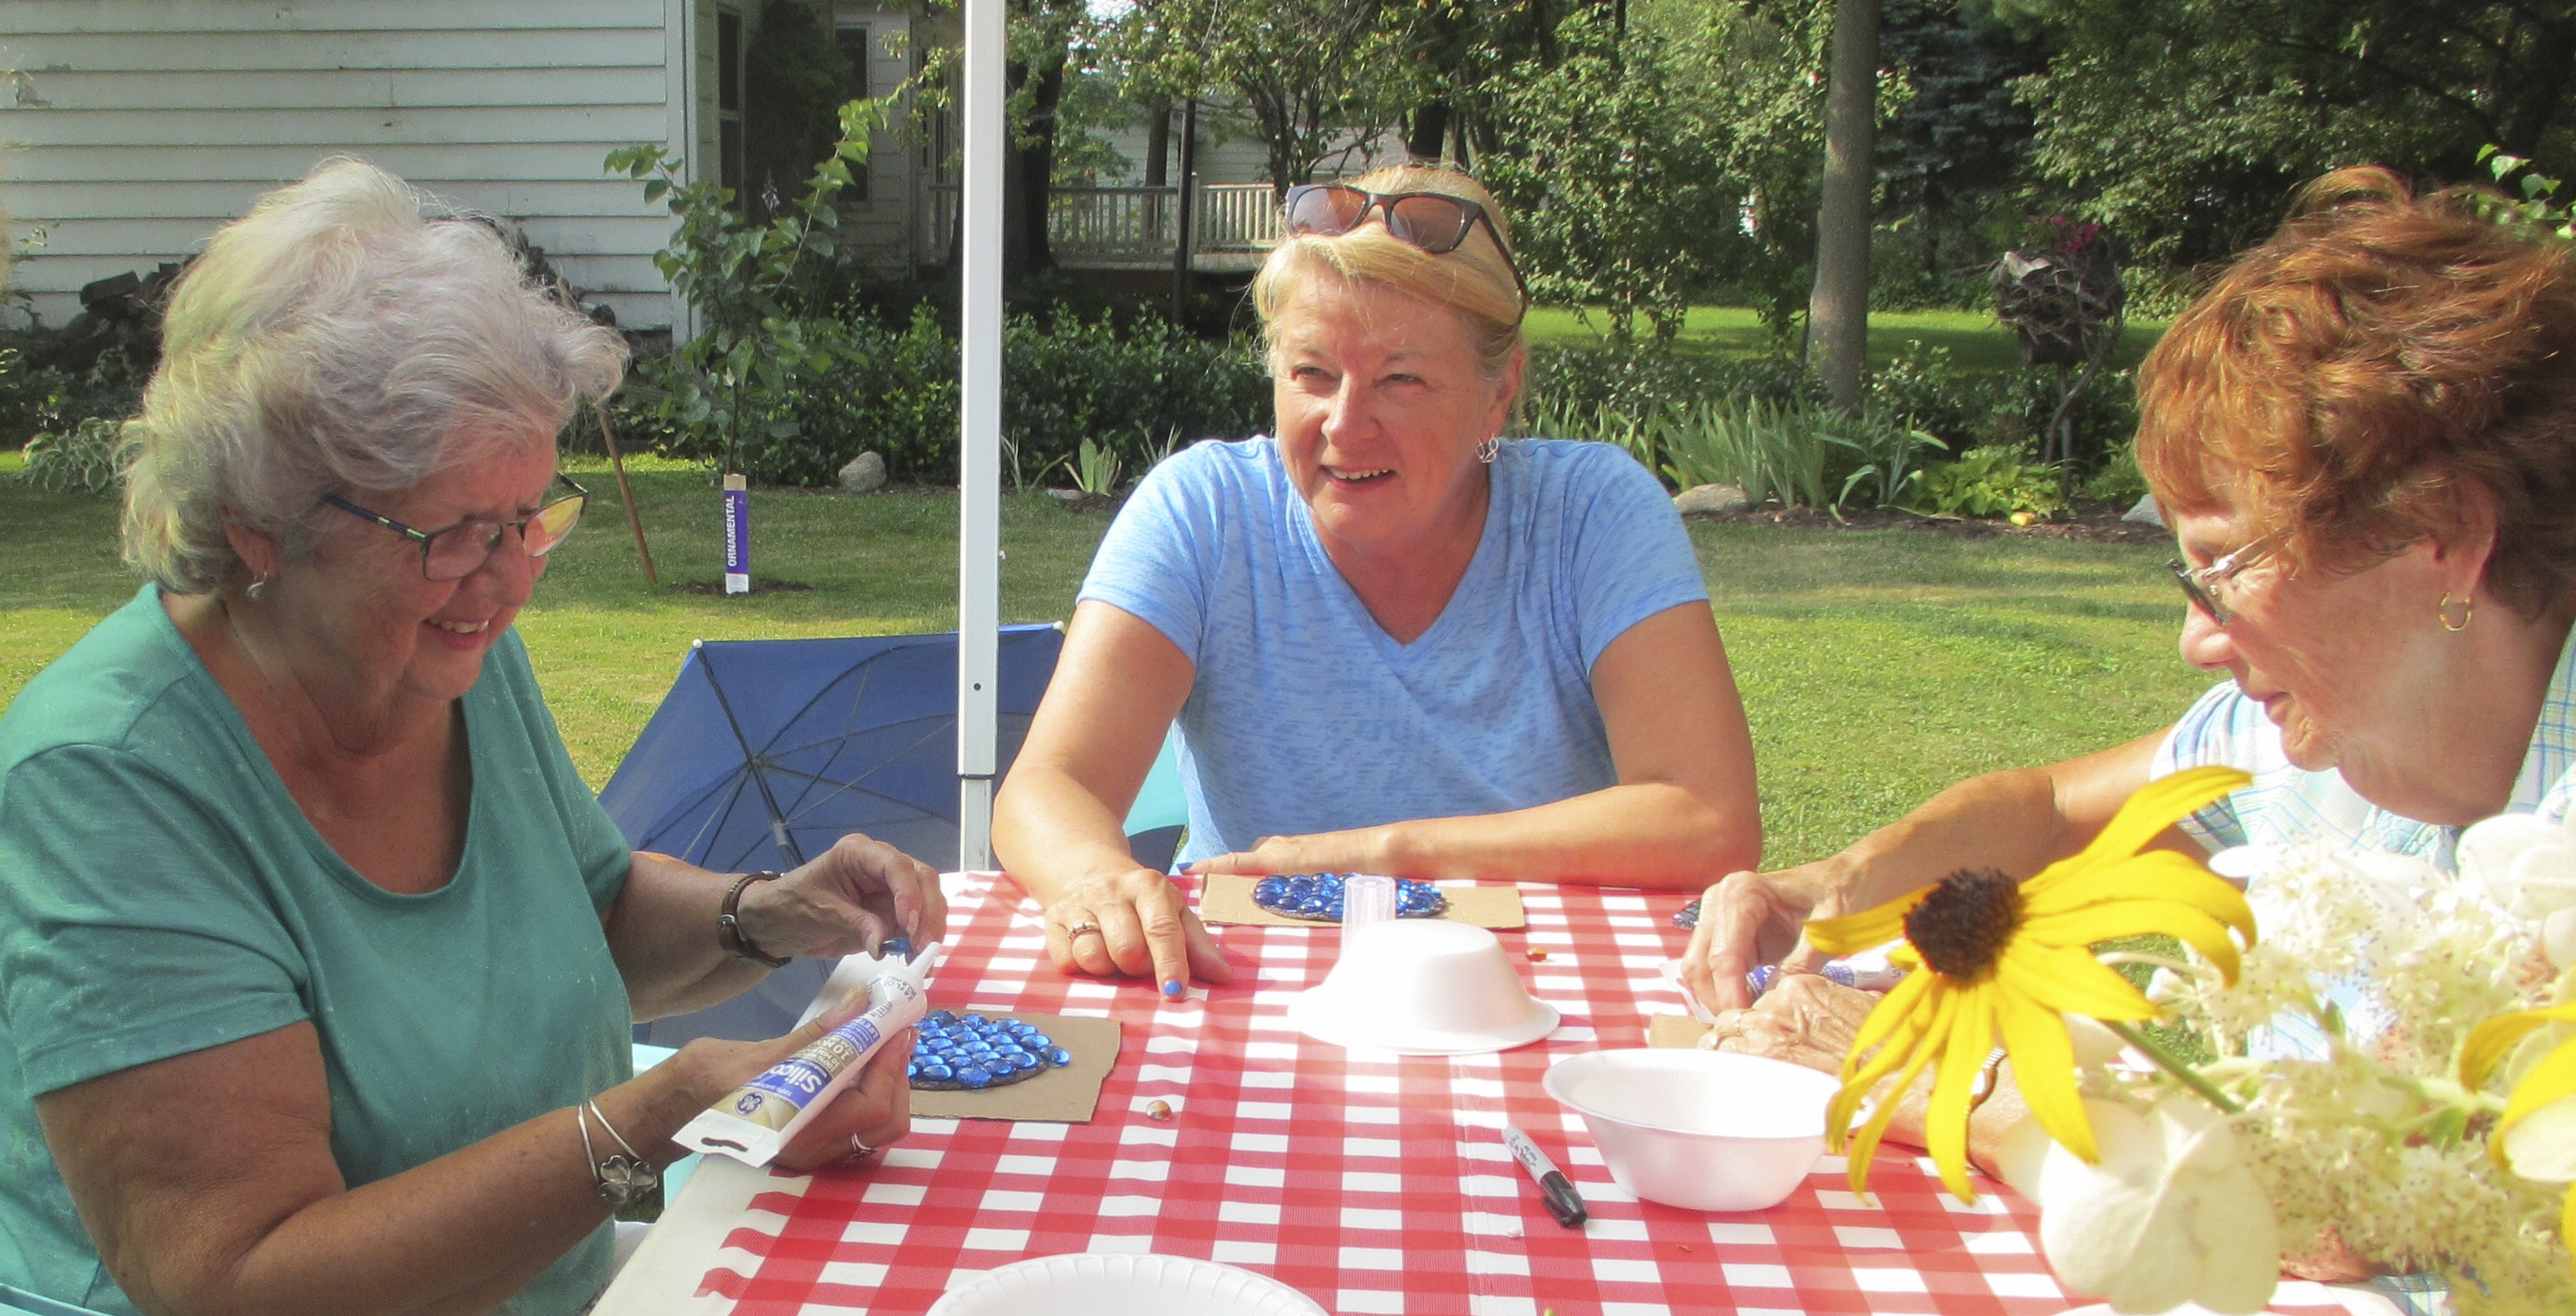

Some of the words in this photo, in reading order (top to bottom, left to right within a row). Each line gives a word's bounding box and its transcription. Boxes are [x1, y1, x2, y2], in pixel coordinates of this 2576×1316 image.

[726, 496, 737, 566] ORNAMENTAL
[831, 1044, 850, 1061] 10
[817, 1054, 836, 1072] 100%
[768, 1062, 822, 1093] Silico
[738, 1093, 762, 1113] GE
